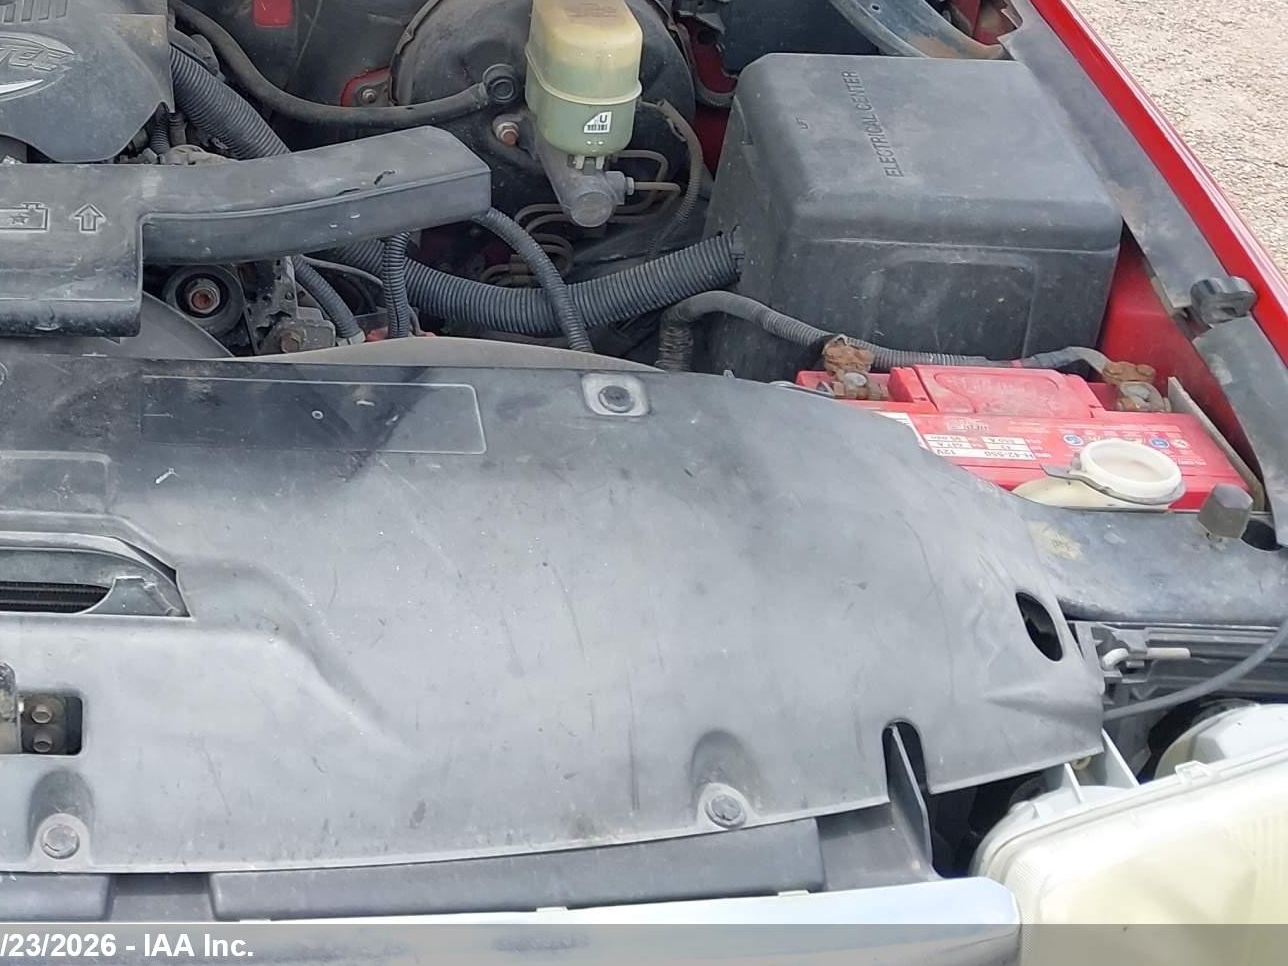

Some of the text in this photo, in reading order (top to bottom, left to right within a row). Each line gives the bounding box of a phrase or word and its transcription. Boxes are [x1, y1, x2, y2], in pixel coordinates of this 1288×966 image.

[599, 114, 608, 123] U
[840, 70, 905, 177] ELECTRICAL CENTER
